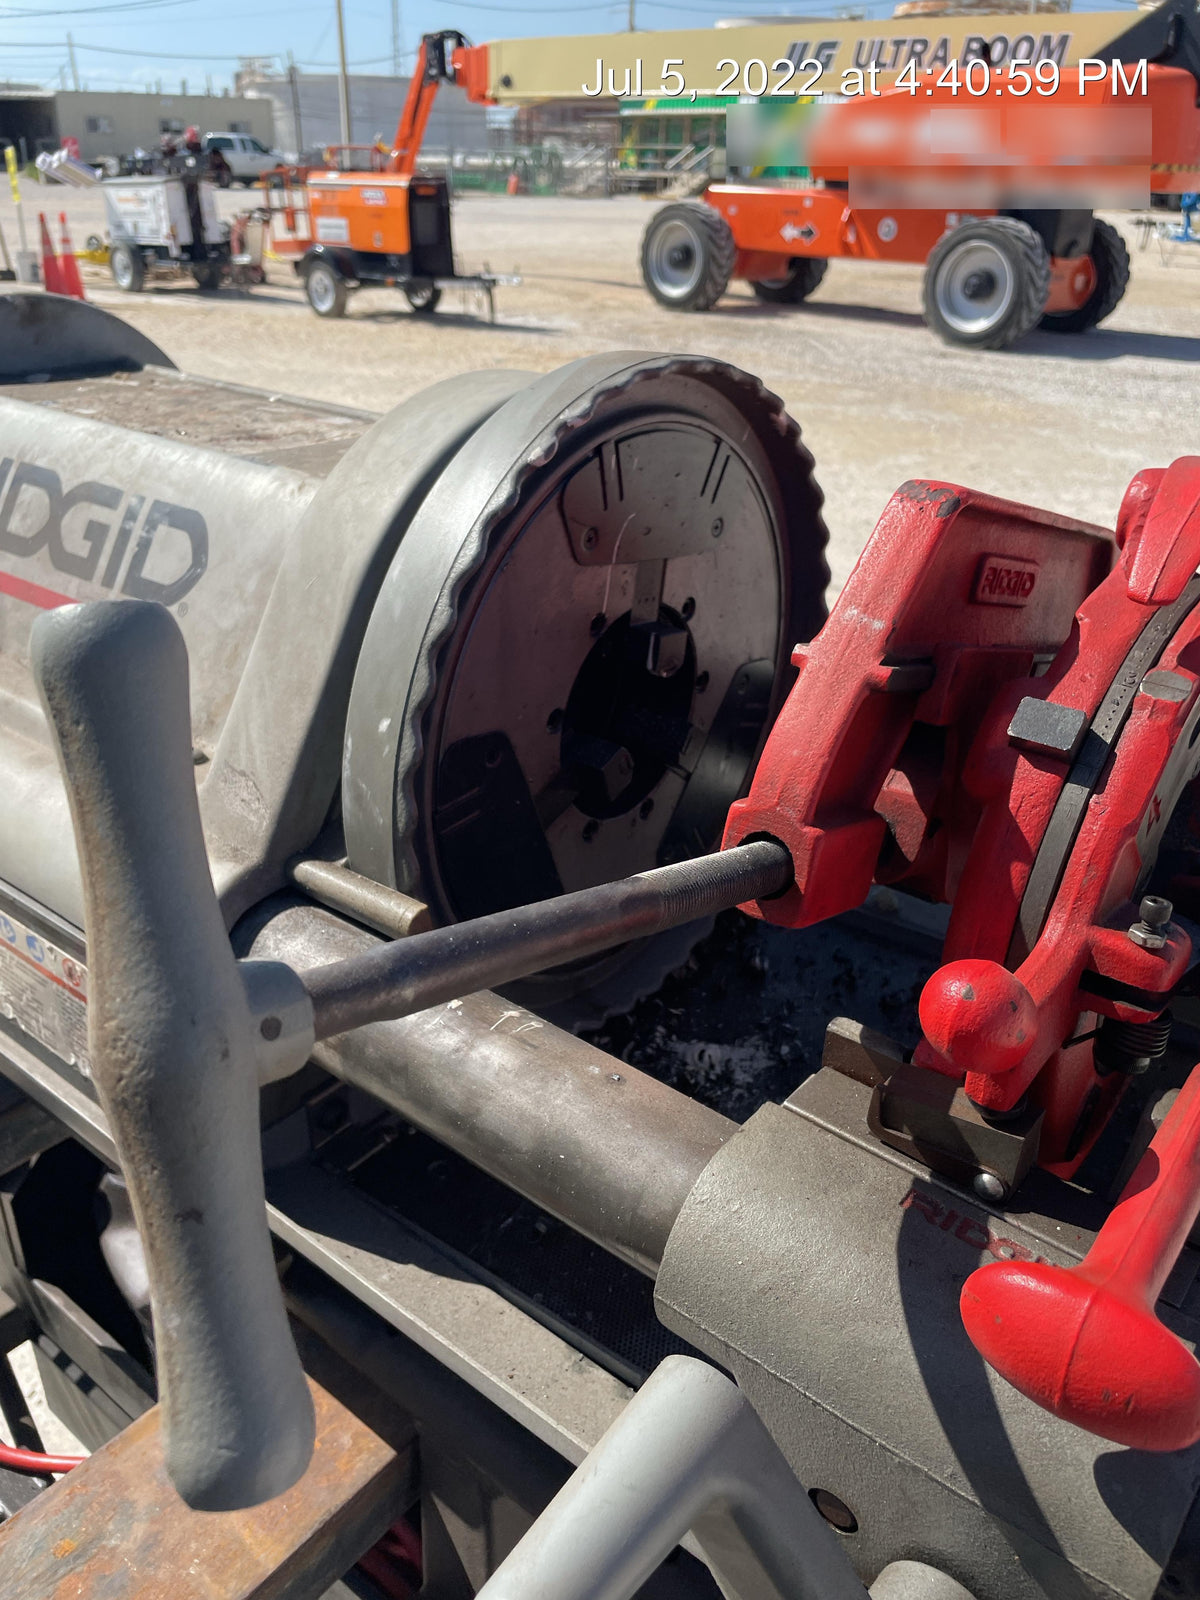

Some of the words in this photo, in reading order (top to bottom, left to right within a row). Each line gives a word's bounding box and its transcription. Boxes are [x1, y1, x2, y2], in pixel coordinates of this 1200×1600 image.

[854, 37, 951, 68] ULTRA
[961, 34, 1070, 68] BOOM
[899, 1188, 1059, 1267] RIDG
